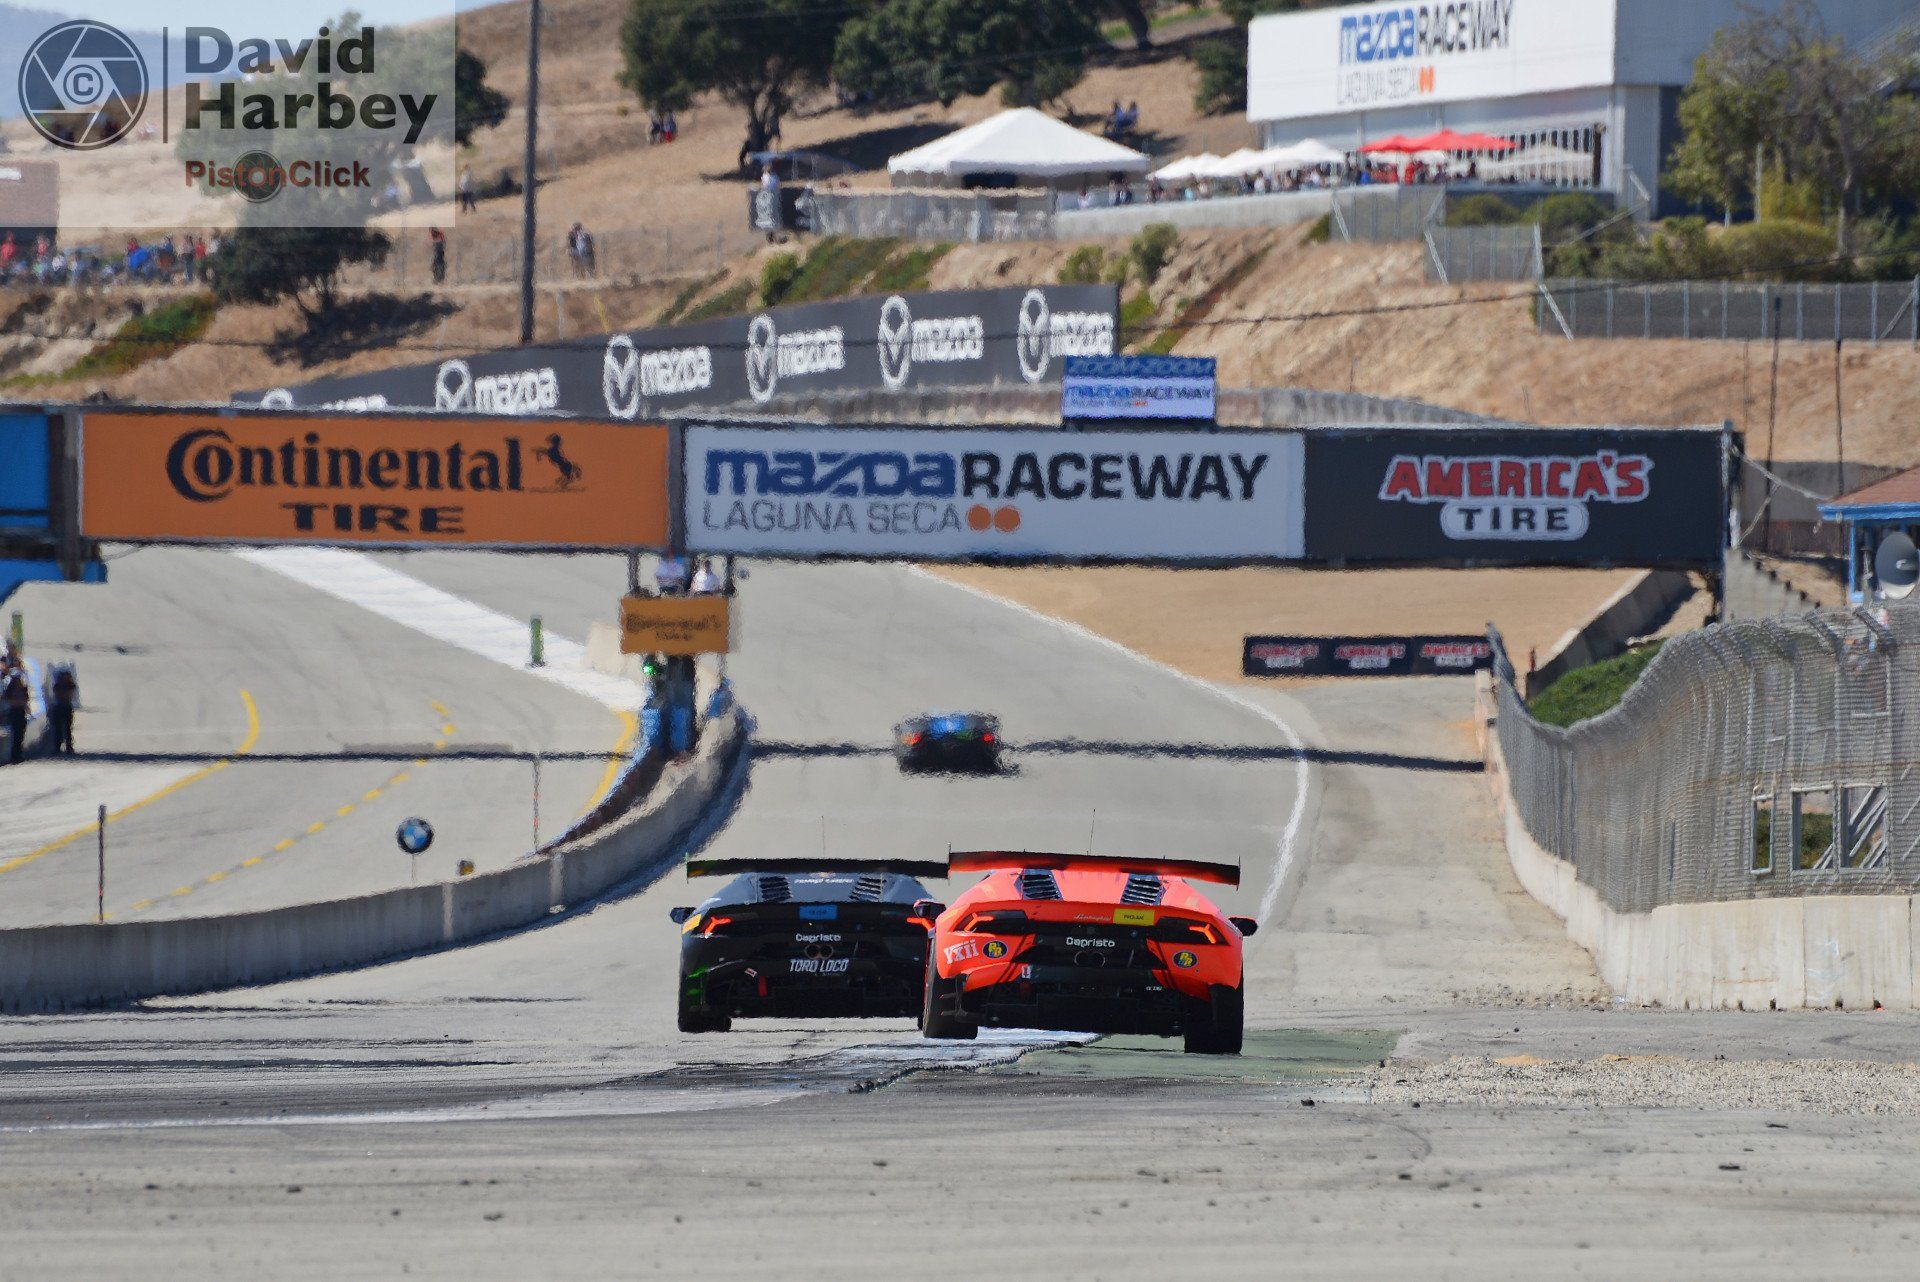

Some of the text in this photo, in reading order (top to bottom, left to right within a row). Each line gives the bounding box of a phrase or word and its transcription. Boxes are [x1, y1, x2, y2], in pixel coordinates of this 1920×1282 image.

[1417, 0, 1512, 54] RACEWAY
[166, 428, 525, 502] Continental
[705, 450, 1269, 500] mazda RACEWAY
[1380, 450, 1653, 502] AMERICA'S
[281, 503, 465, 534] TIRE
[702, 500, 962, 535] LAGUNA SECA
[1457, 507, 1569, 531] TIRE
[795, 933, 842, 943] Capristo
[1066, 936, 1116, 948] Capristo
[790, 958, 850, 973] TORO LOCO
